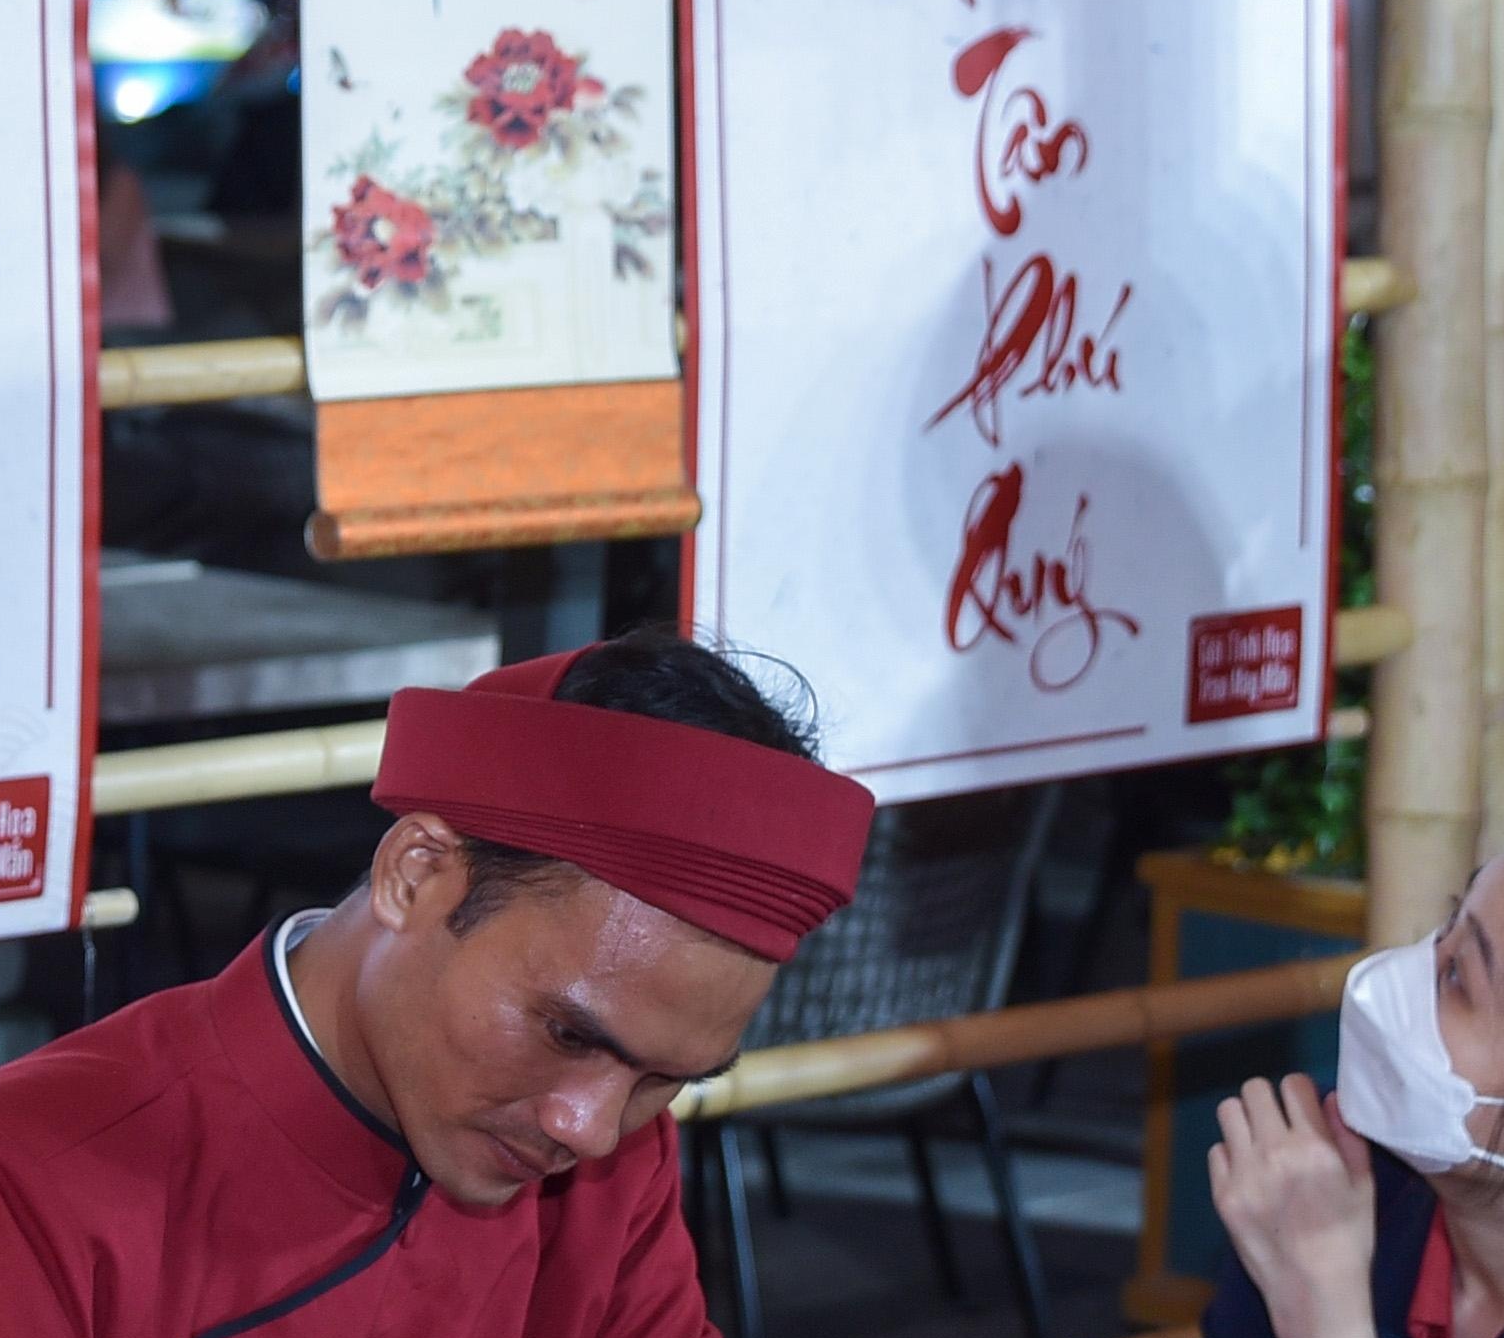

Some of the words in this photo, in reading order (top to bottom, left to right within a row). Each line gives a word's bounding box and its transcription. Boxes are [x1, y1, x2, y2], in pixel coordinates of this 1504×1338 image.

[951, 26, 1091, 237] Tân
[923, 251, 1137, 448] Phú
[942, 461, 1142, 693] Quý
